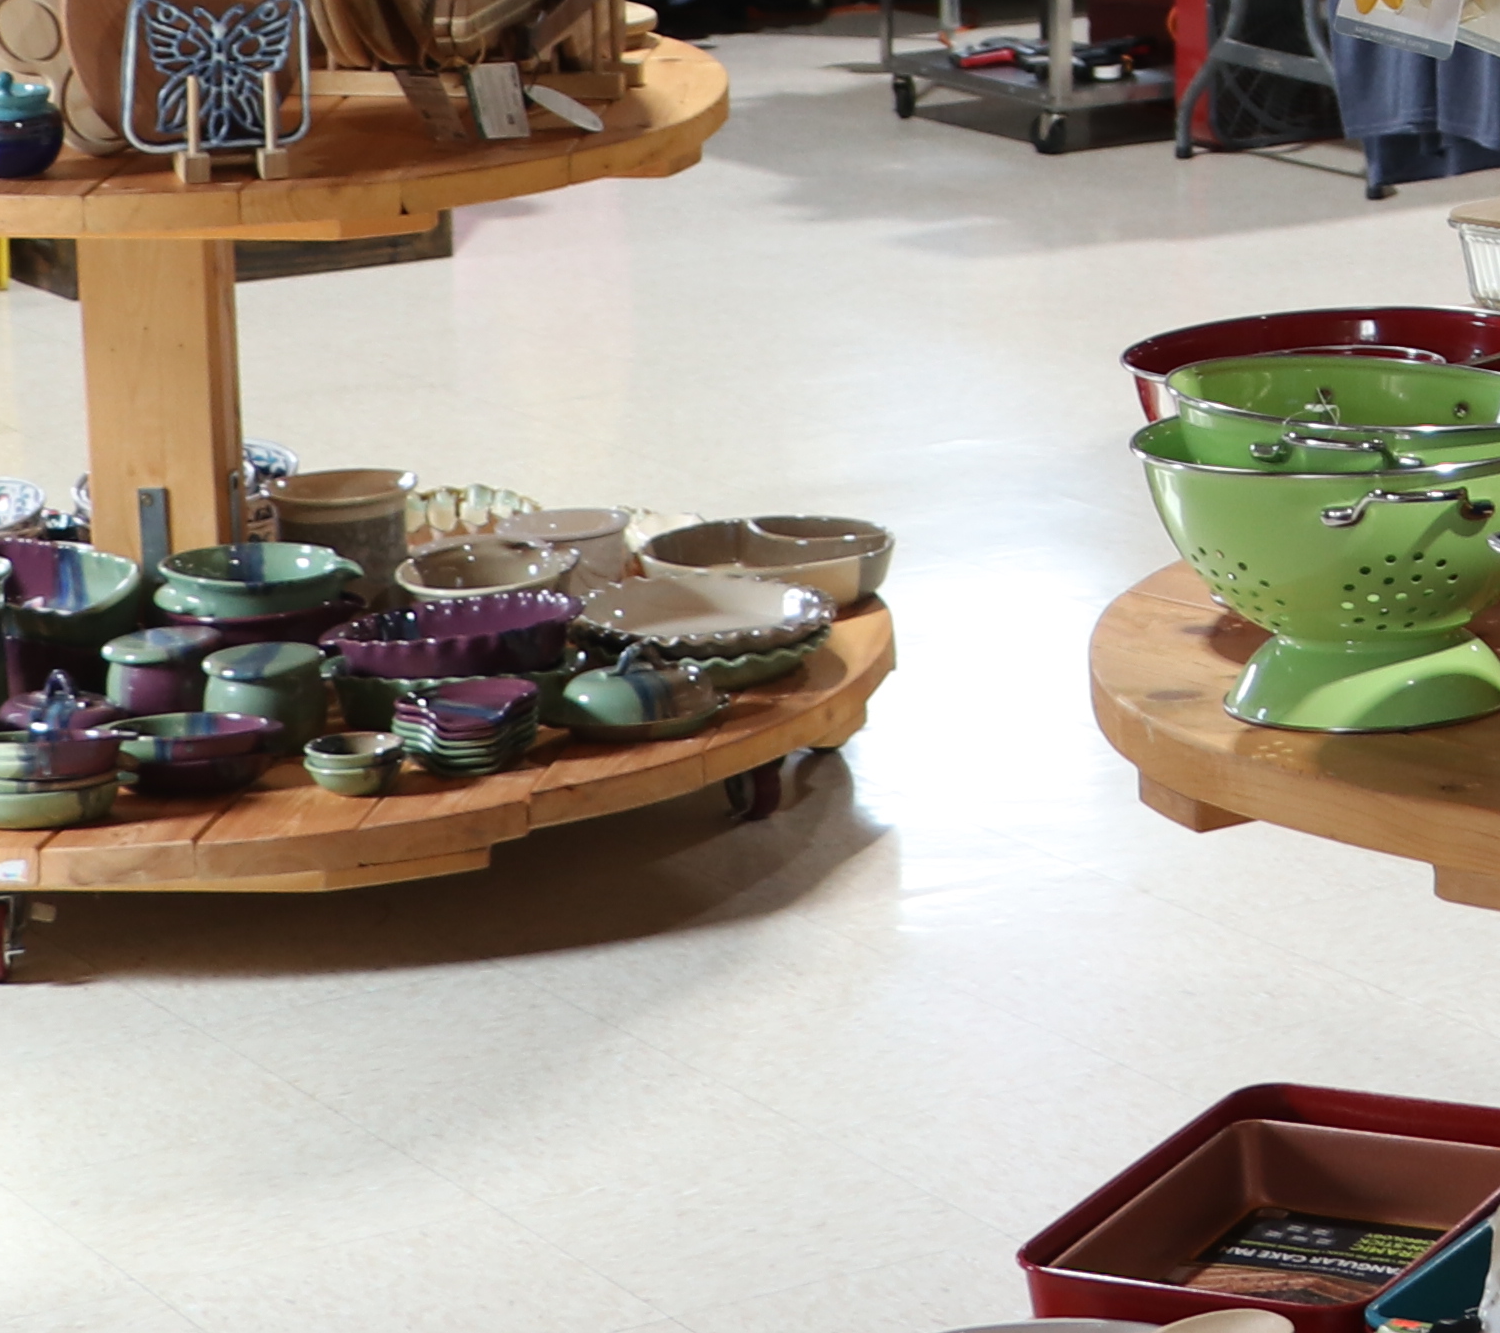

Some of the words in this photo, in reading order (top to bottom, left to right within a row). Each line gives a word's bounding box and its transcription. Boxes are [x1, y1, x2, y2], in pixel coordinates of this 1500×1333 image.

[1220, 1245, 1258, 1258] PAN
[1353, 1237, 1432, 1253] ON-STICK
[1258, 1249, 1309, 1264] CAKE
